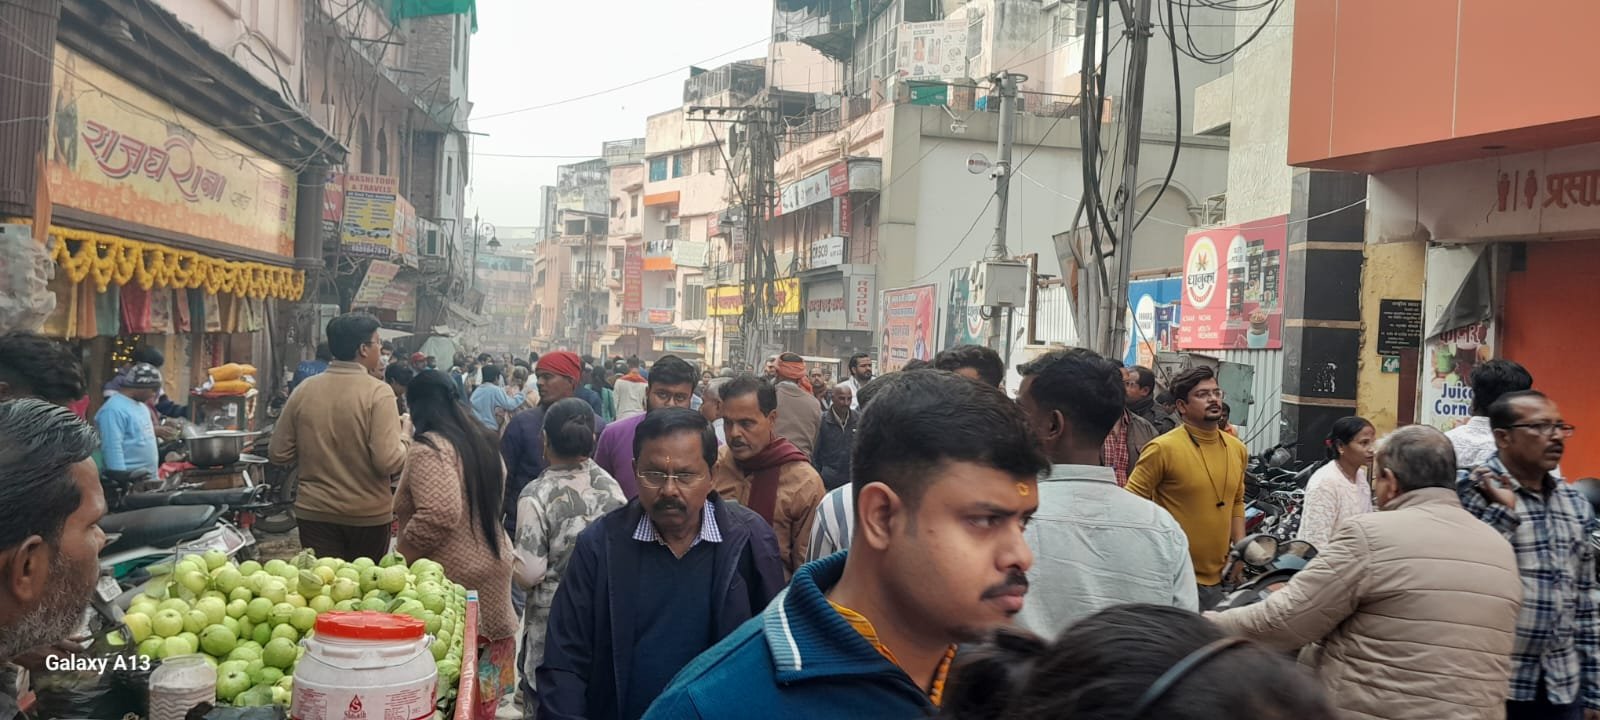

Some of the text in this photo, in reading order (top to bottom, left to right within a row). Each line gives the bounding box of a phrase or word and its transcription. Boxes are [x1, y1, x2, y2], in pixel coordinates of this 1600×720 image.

[81, 119, 227, 203] राजघराना
[376, 176, 395, 185] TOUR
[360, 184, 392, 193] TRAVELS
[1187, 271, 1215, 290] धानुका
